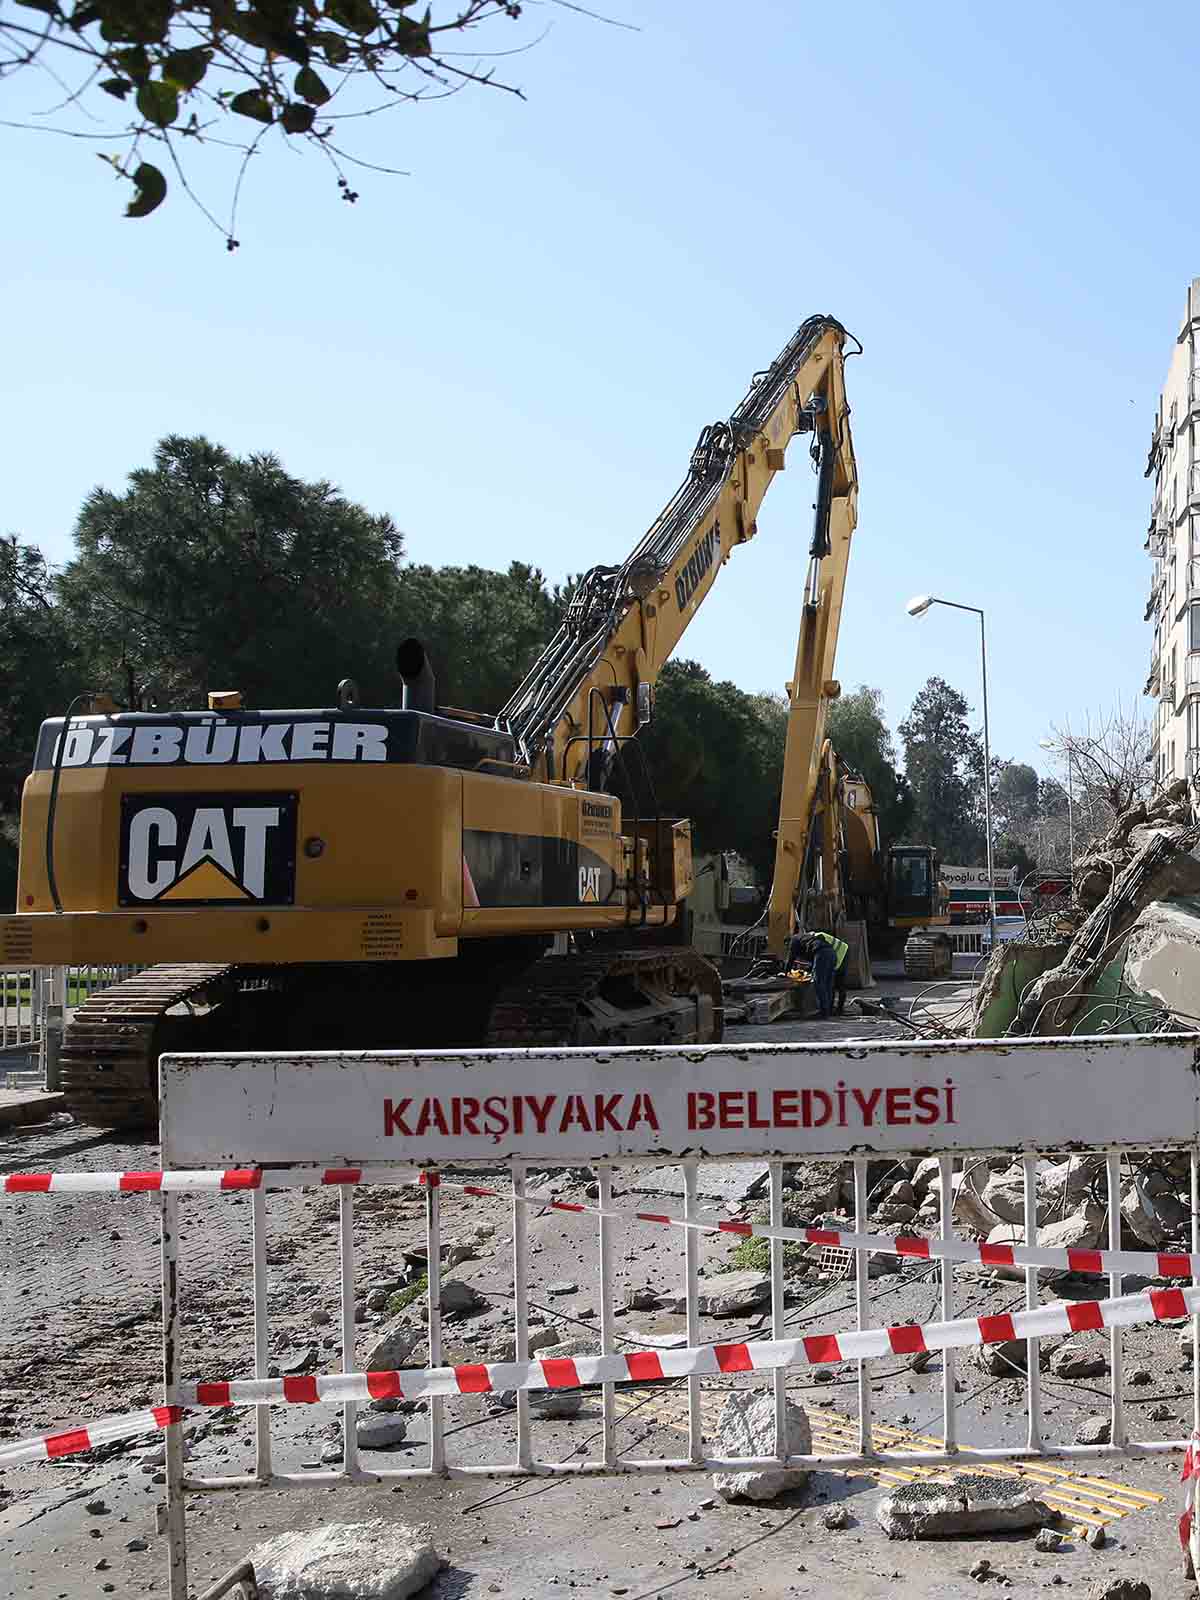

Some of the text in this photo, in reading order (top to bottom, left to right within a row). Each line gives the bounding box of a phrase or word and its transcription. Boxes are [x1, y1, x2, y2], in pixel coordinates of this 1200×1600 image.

[52, 719, 389, 767] ÖZBÜKER
[128, 807, 280, 900] CAT
[578, 866, 601, 902] CAT
[383, 1077, 957, 1144] KARŞIYAKA BELEDİYESİ
